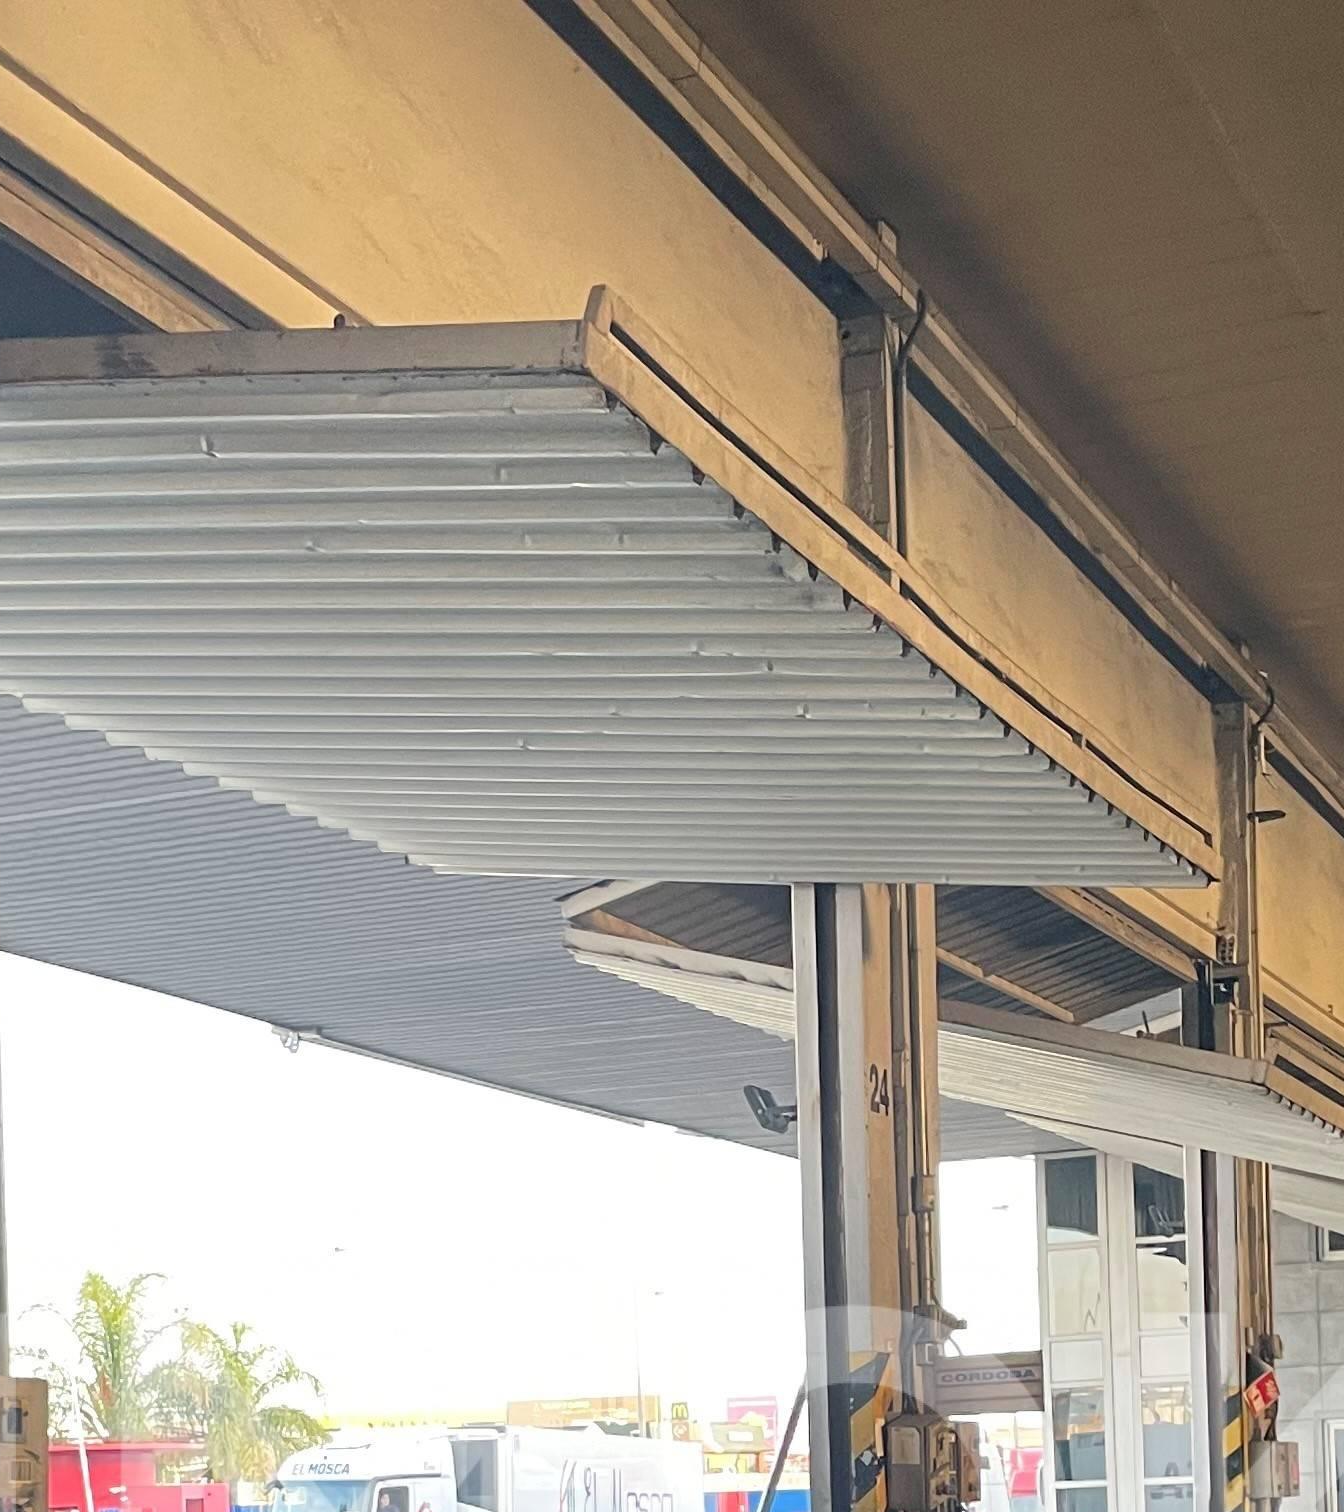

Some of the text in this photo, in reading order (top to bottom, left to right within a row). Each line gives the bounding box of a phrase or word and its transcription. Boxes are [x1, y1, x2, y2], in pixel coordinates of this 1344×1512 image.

[869, 1063, 890, 1117] 24
[291, 1463, 350, 1476] EL MOSCA
